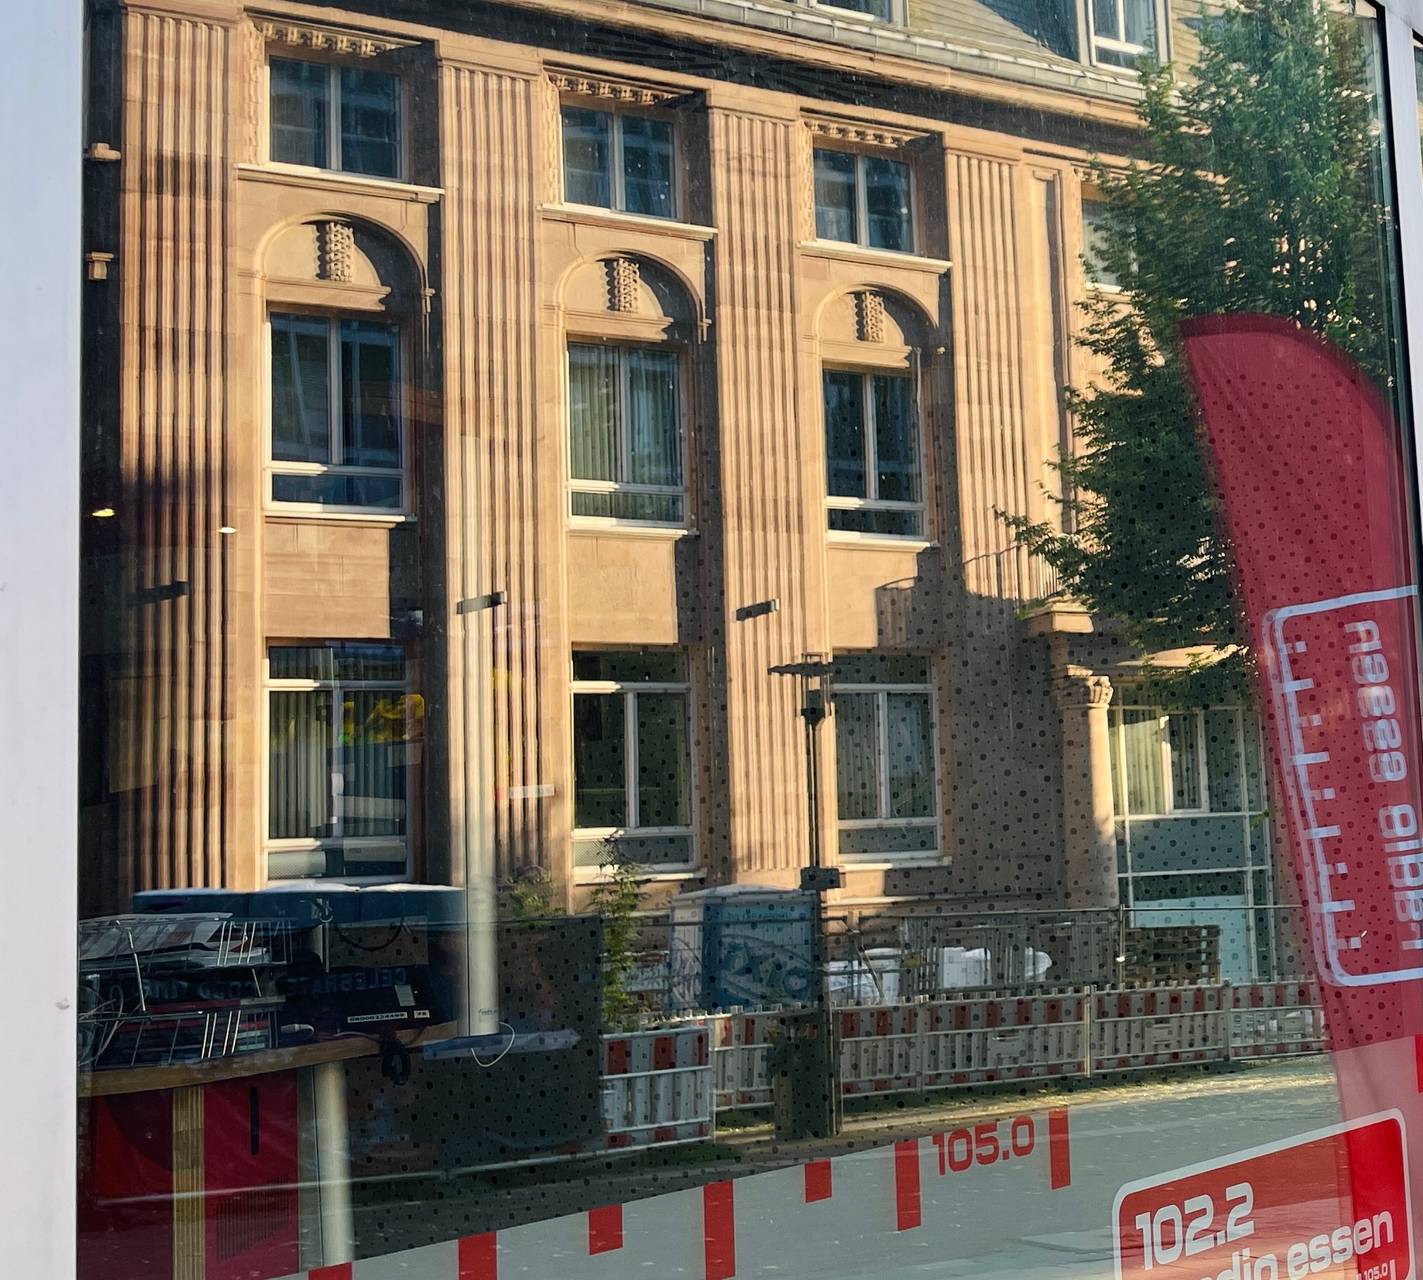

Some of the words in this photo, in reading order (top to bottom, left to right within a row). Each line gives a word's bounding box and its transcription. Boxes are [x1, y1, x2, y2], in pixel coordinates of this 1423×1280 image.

[932, 1114, 1035, 1176] 105.0
[1135, 1182, 1255, 1272] 102.2
[1286, 1210, 1394, 1280] essen
[1363, 1262, 1389, 1280] 105.0
